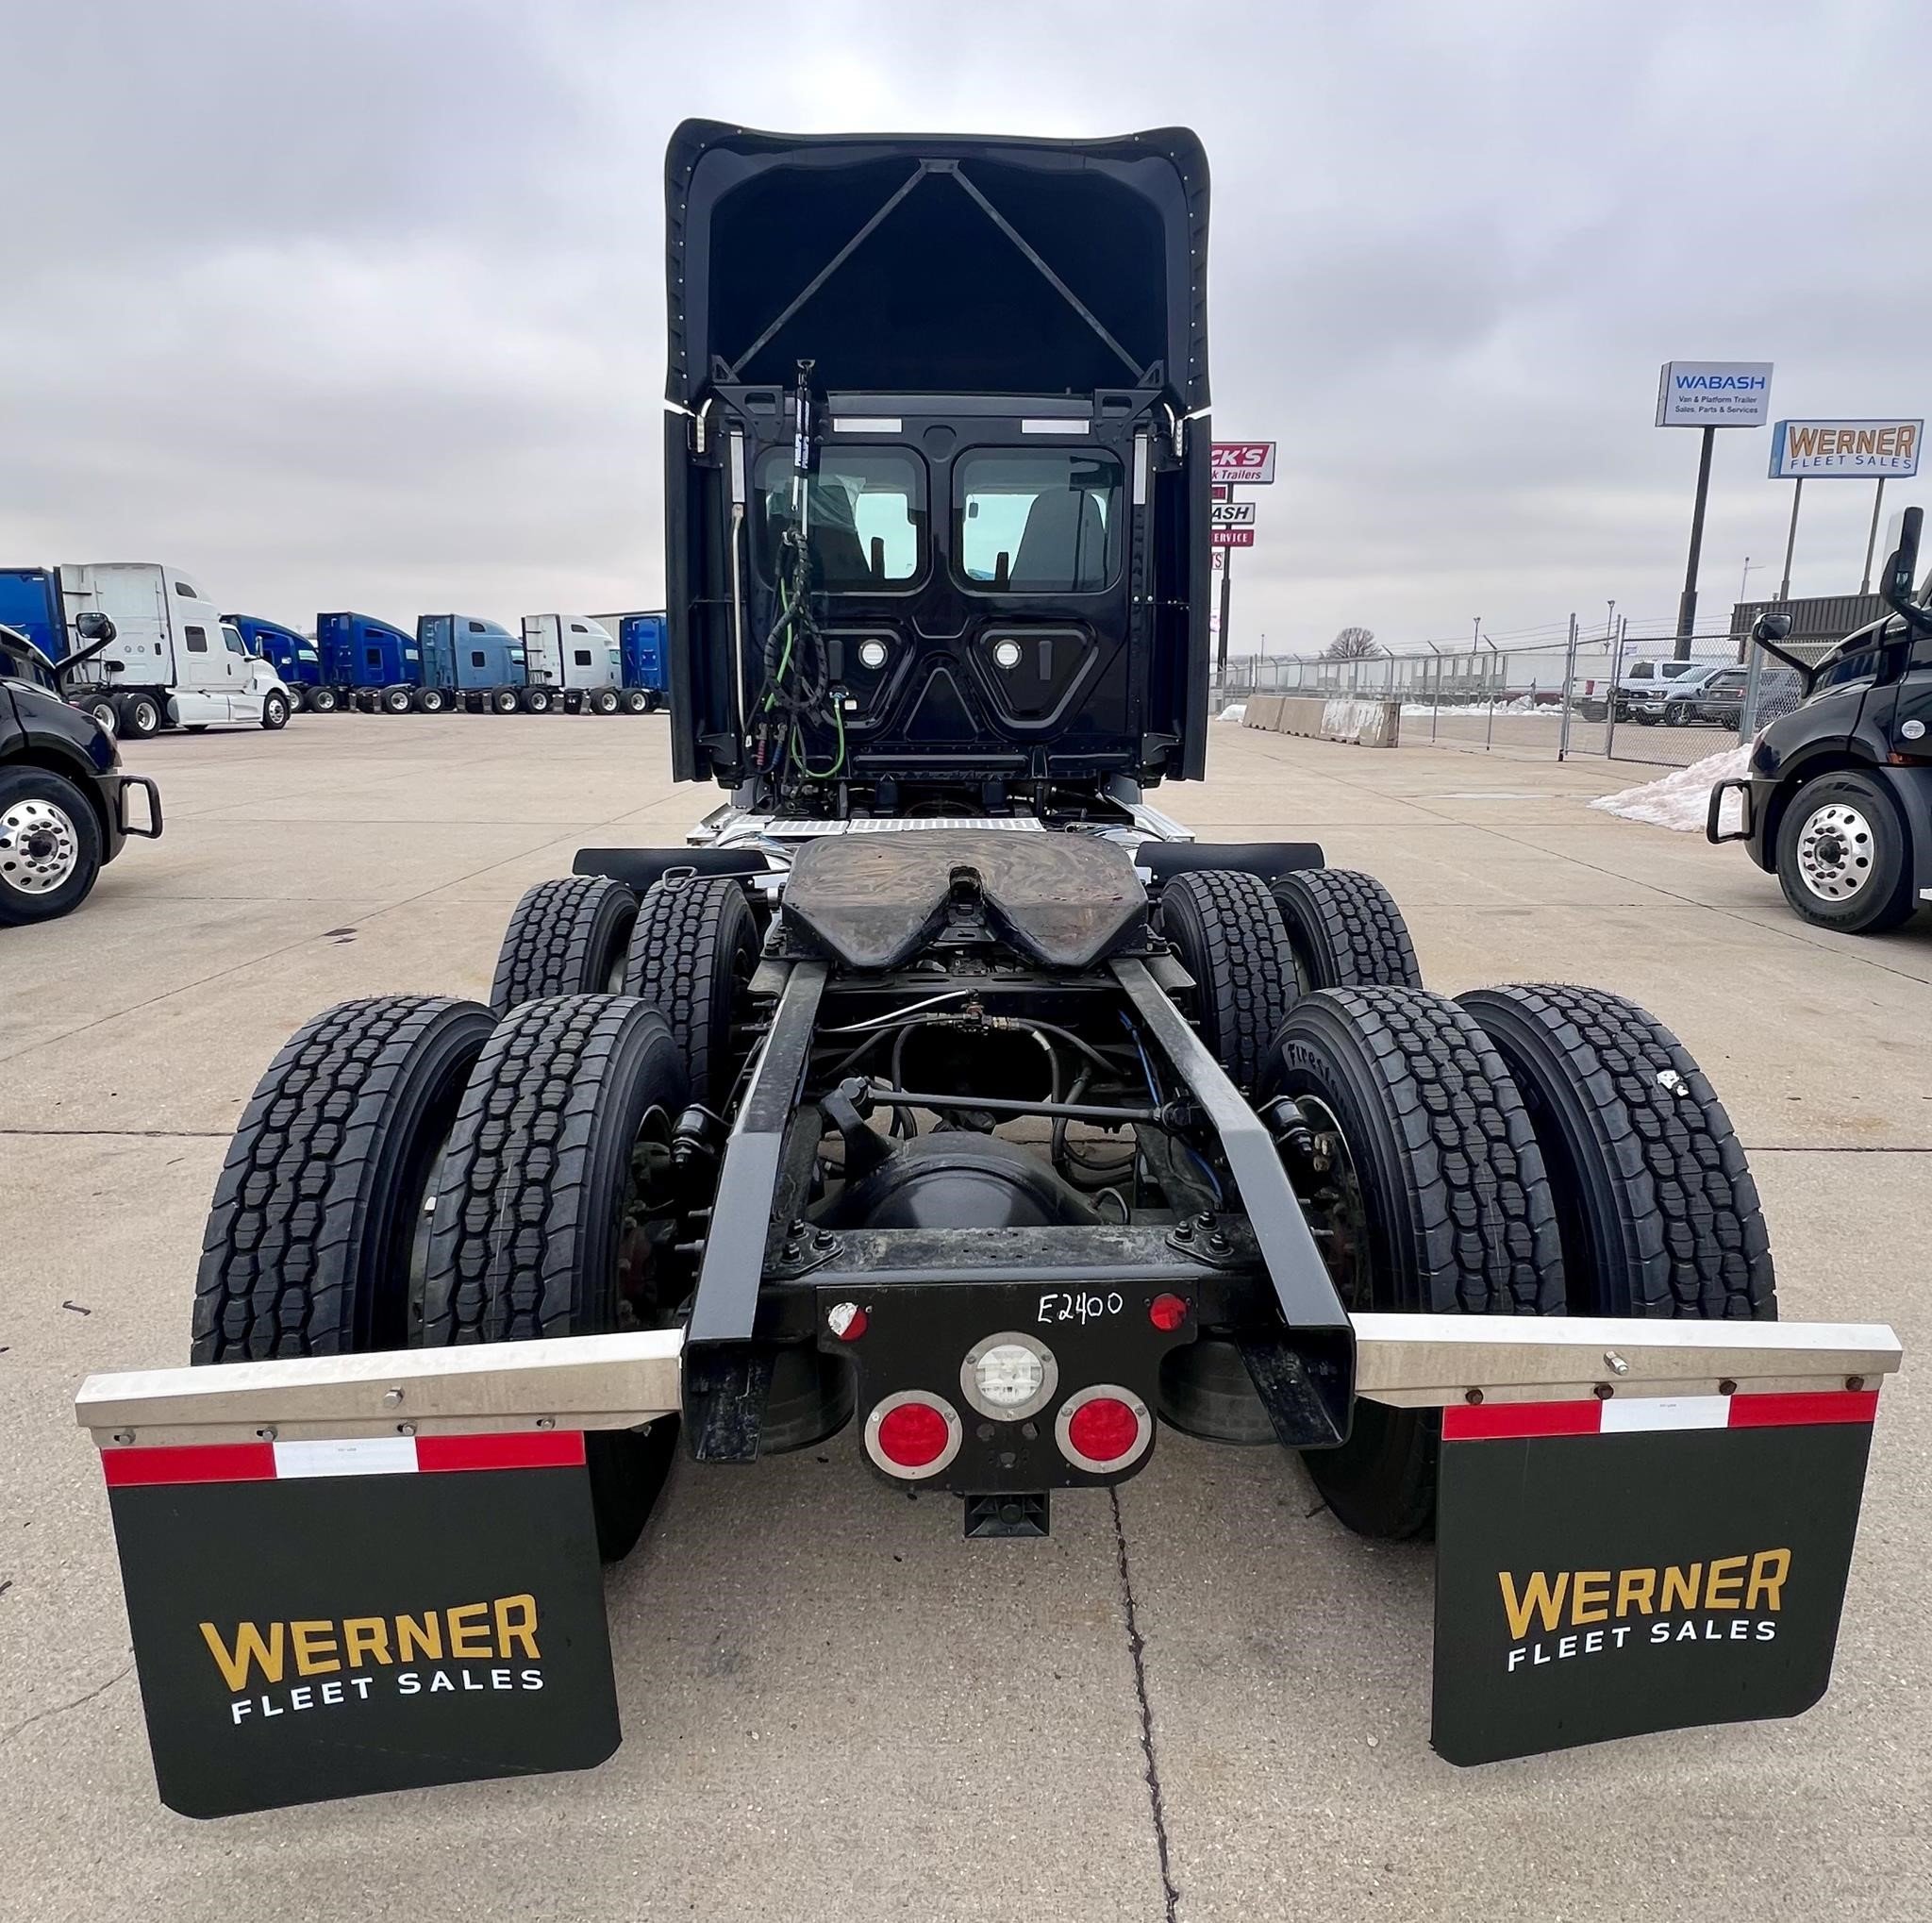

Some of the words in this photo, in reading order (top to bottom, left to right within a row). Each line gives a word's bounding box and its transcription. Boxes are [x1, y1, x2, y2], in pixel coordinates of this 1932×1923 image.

[1675, 376, 1765, 390] WABASH
[1789, 424, 1916, 459] WERNER
[1222, 470, 1261, 479] Trailers
[1790, 455, 1847, 470] FLEET
[1855, 455, 1912, 470] SALES
[1038, 1292, 1124, 1326] E2400
[1498, 1547, 1791, 1641] WERNER
[199, 1594, 541, 1692] WERNER
[1507, 1626, 1632, 1672] FLEET
[1650, 1619, 1777, 1643] SALES
[231, 1677, 374, 1725] FLEET
[397, 1668, 545, 1695] SALES
